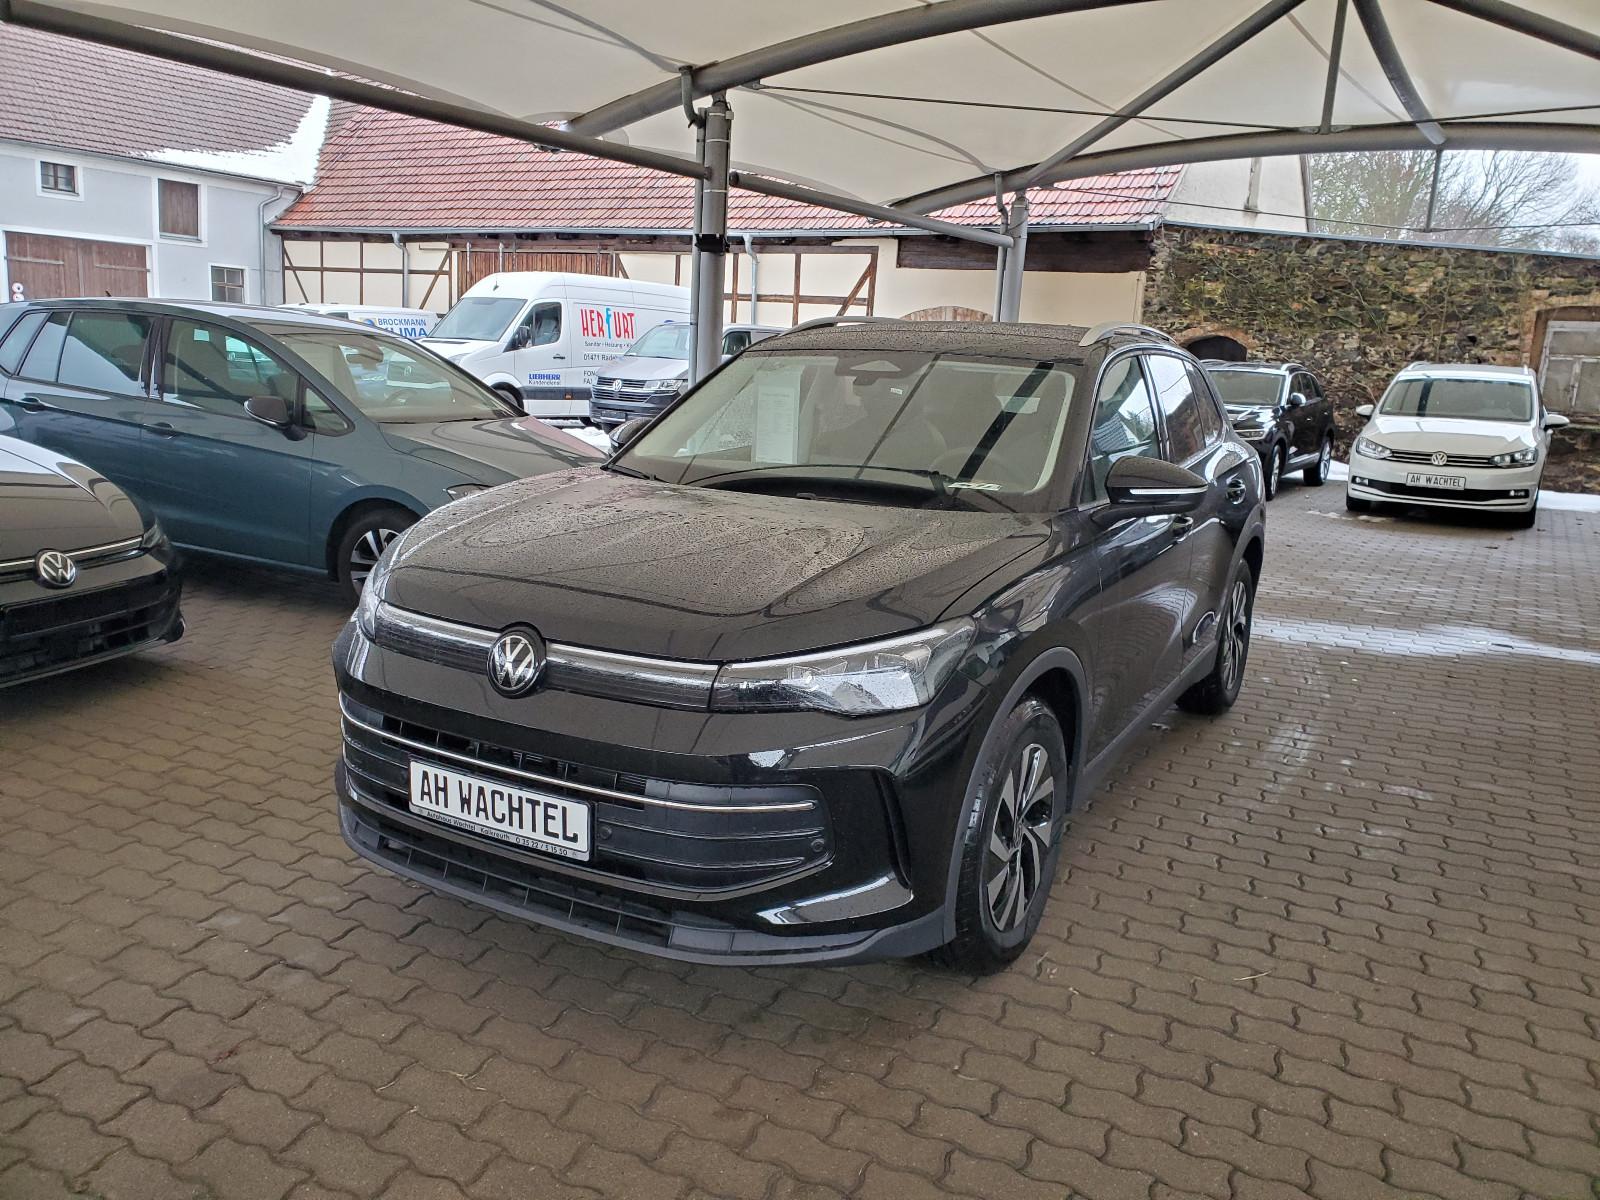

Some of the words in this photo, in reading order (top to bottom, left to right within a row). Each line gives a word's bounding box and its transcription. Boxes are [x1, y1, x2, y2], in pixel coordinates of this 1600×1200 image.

[378, 318, 426, 326] BROCKMANN
[384, 327, 428, 337] IMA
[1410, 474, 1421, 483] AH
[1426, 476, 1461, 487] WACHTEL
[420, 769, 449, 809] AH
[458, 779, 579, 844] WACHTEL
[426, 811, 452, 824] Autohaus
[453, 820, 476, 832] Wachtel
